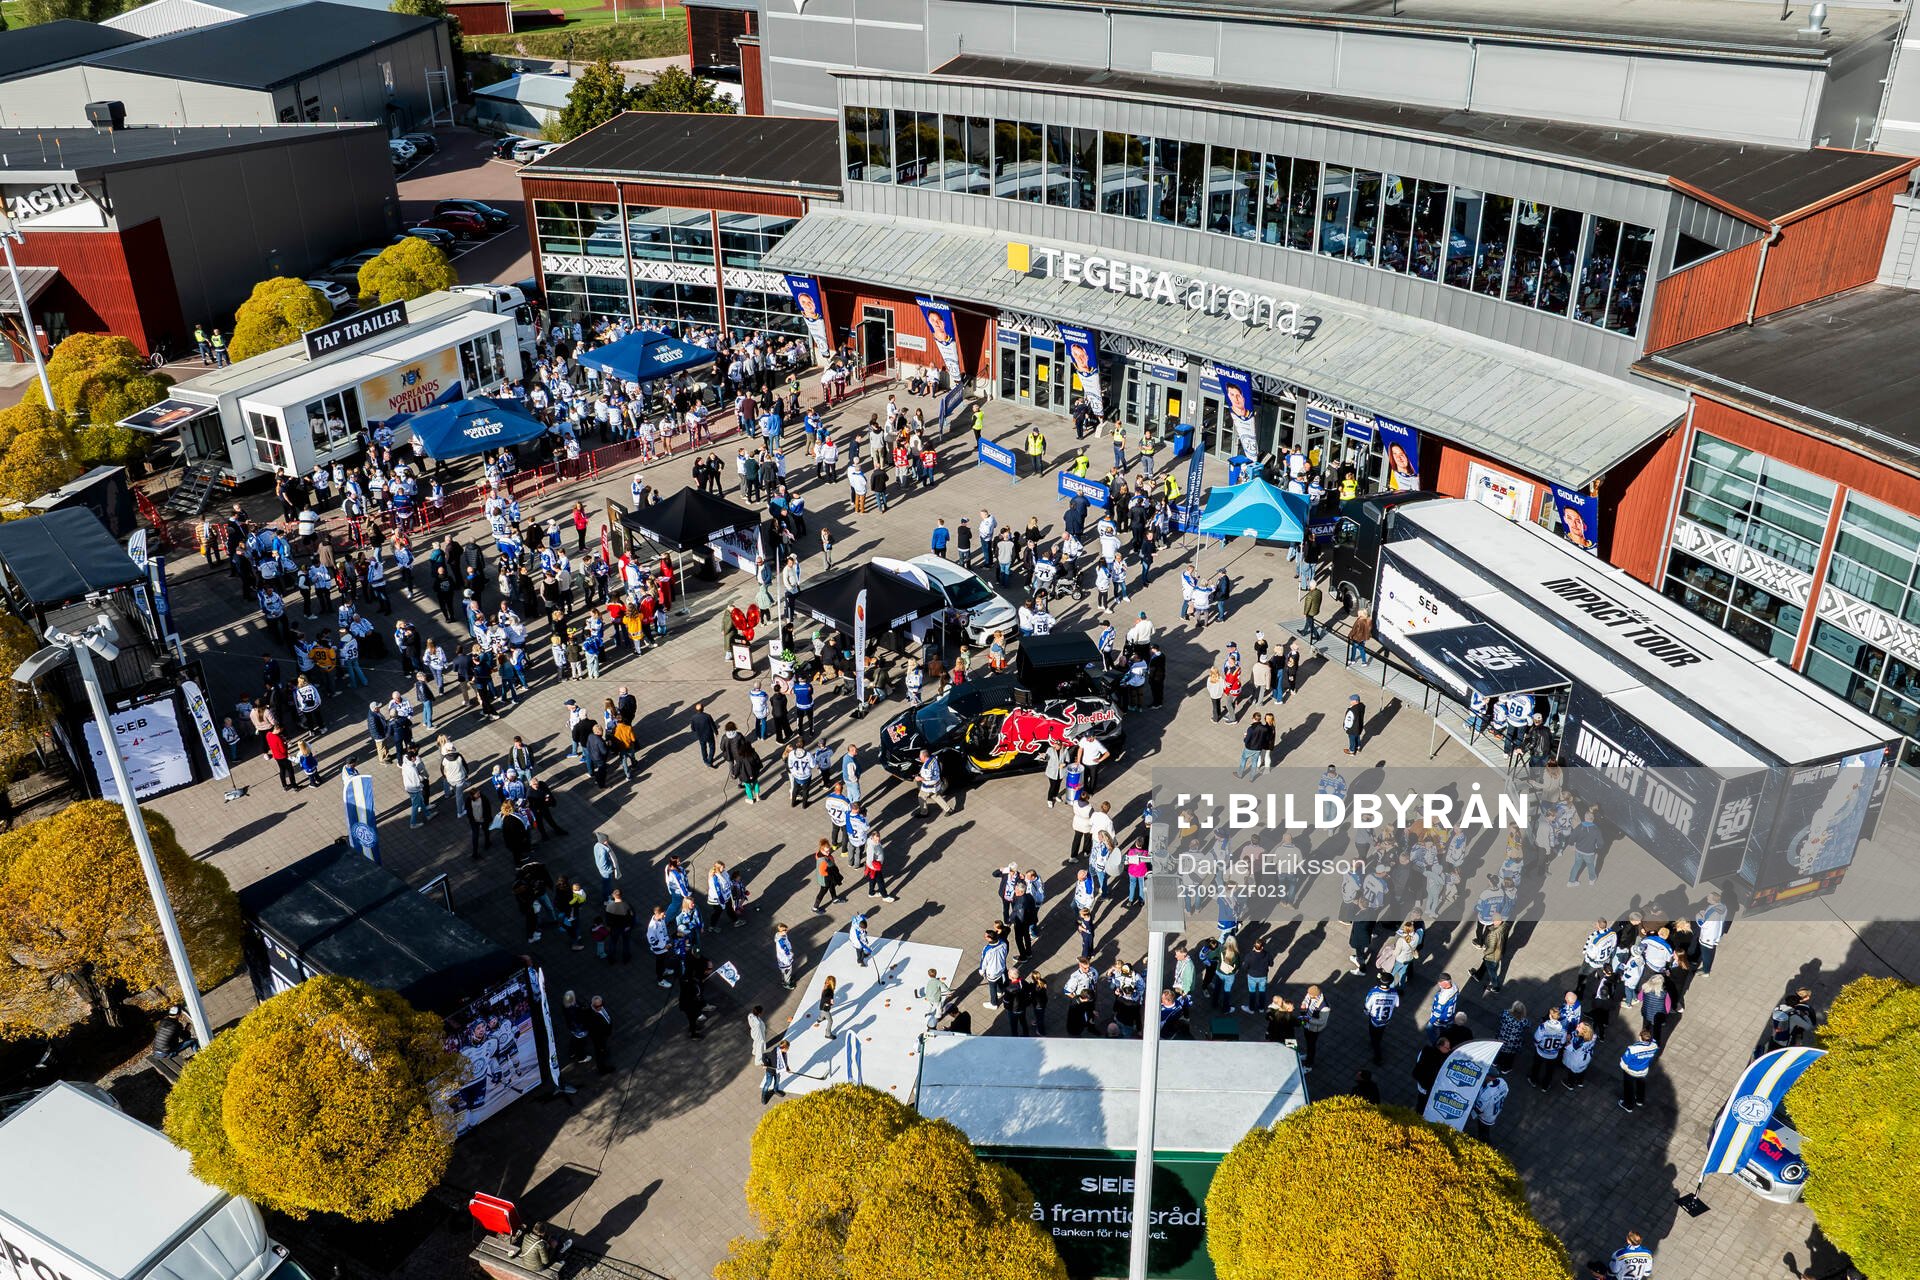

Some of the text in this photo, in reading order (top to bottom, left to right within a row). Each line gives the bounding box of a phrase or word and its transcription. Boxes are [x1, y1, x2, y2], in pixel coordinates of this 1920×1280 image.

[1188, 276, 1301, 337] arena
[314, 308, 402, 351] TAP TRAILER
[388, 378, 440, 410] NORRLANDS
[397, 391, 437, 415] GULD
[463, 422, 504, 437] NORRLANDS
[470, 426, 501, 439] GULD
[1379, 420, 1409, 437] RADOVÁ
[1063, 478, 1105, 499] LEKSANDS IF
[1557, 488, 1585, 506] GIDLÖF
[1418, 595, 1439, 616] SEB
[1540, 577, 1702, 668] IMPACT TOUR
[1077, 710, 1115, 724] Red Bull
[1510, 702, 1524, 717] 68
[116, 718, 148, 735] SEB
[1626, 751, 1647, 771] SHL
[1575, 727, 1694, 836] IMPACT TOUR
[1791, 766, 1819, 786] IMPACT
[1723, 797, 1752, 816] SHL
[1717, 810, 1751, 837] 50
[1543, 1038, 1561, 1050] 06
[1759, 1142, 1783, 1161] Bull
[1052, 1227, 1094, 1237] Banken
[1096, 1228, 1112, 1238] för
[1624, 1264, 1642, 1278] 21
